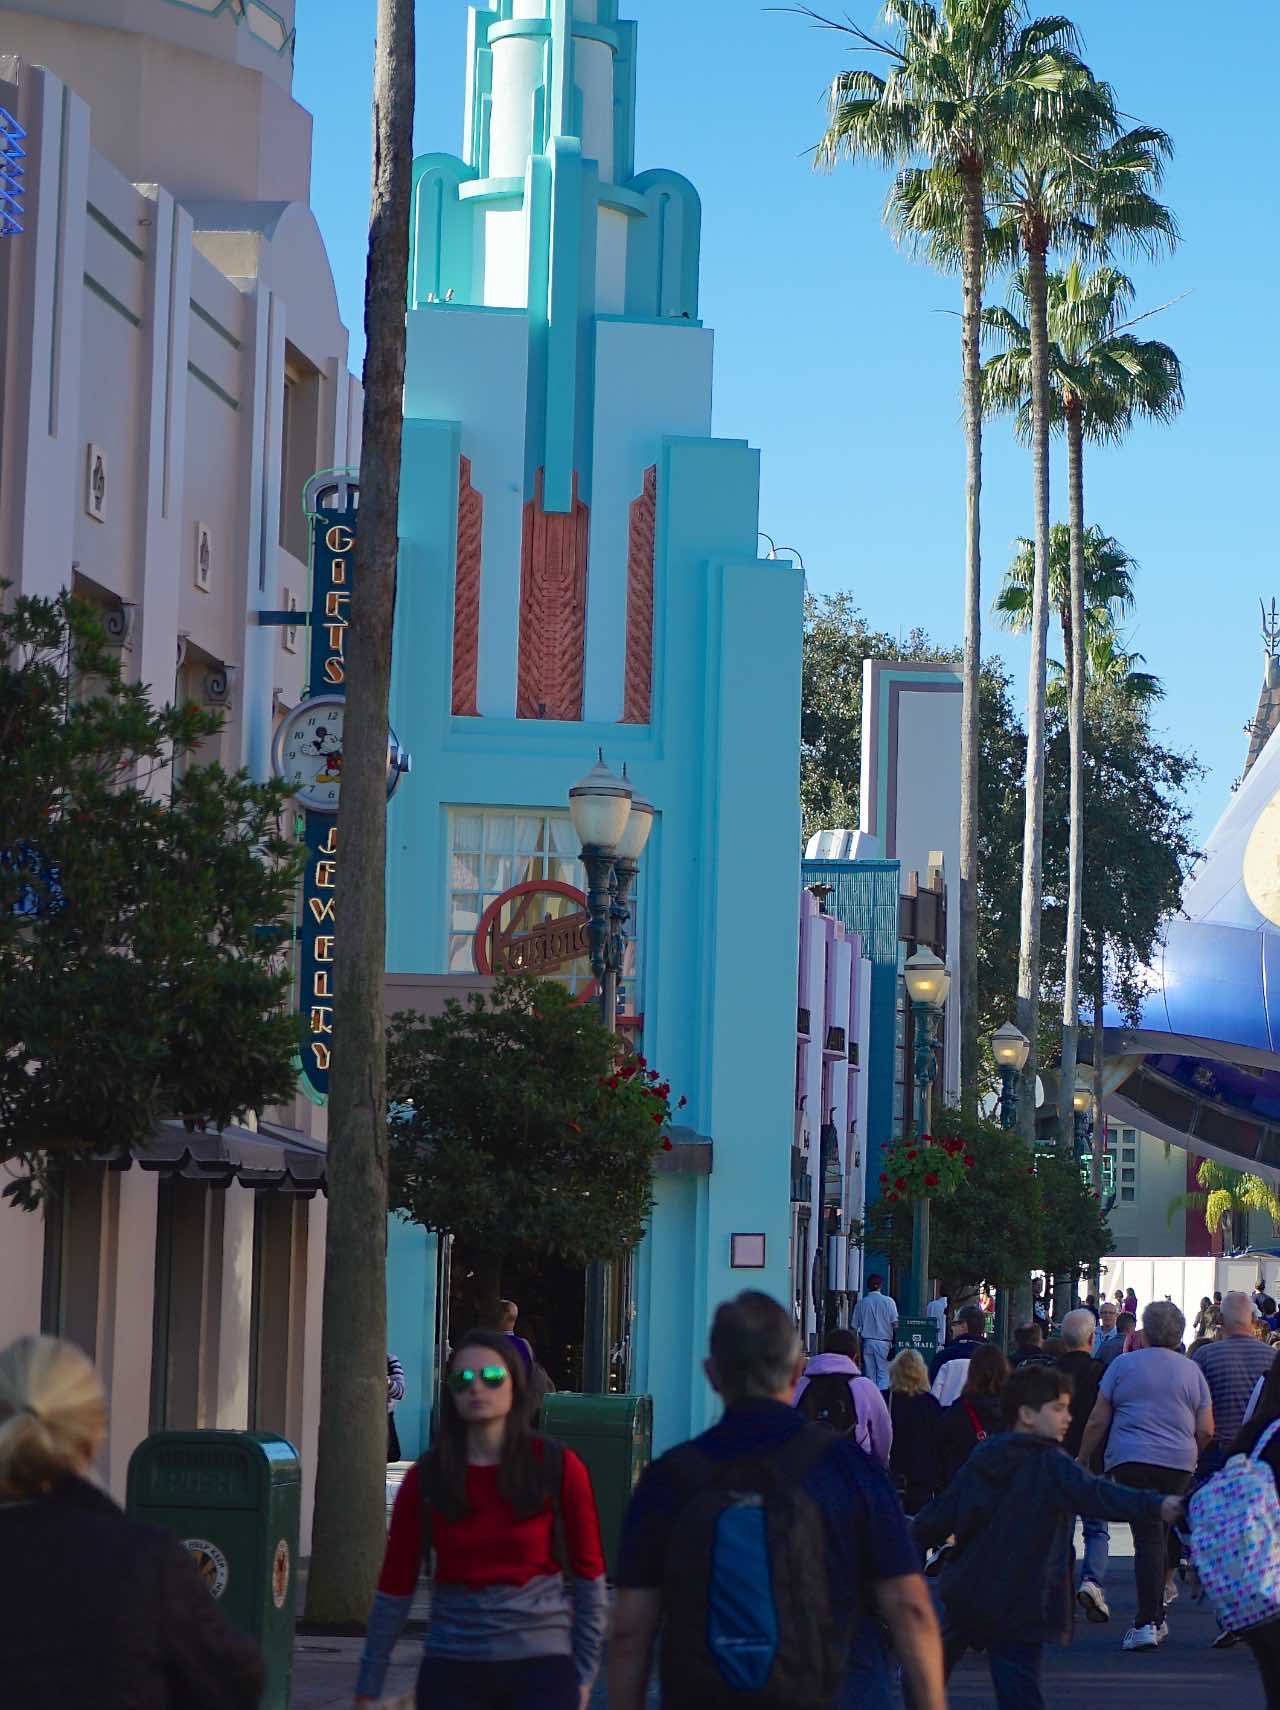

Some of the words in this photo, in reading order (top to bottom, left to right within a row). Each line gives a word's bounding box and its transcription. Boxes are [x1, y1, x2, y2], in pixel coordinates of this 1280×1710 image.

[322, 525, 356, 684] GIFTS
[327, 711, 339, 721] 12
[307, 718, 316, 726] 11
[294, 731, 304, 740] 10
[288, 752, 296, 760] 9
